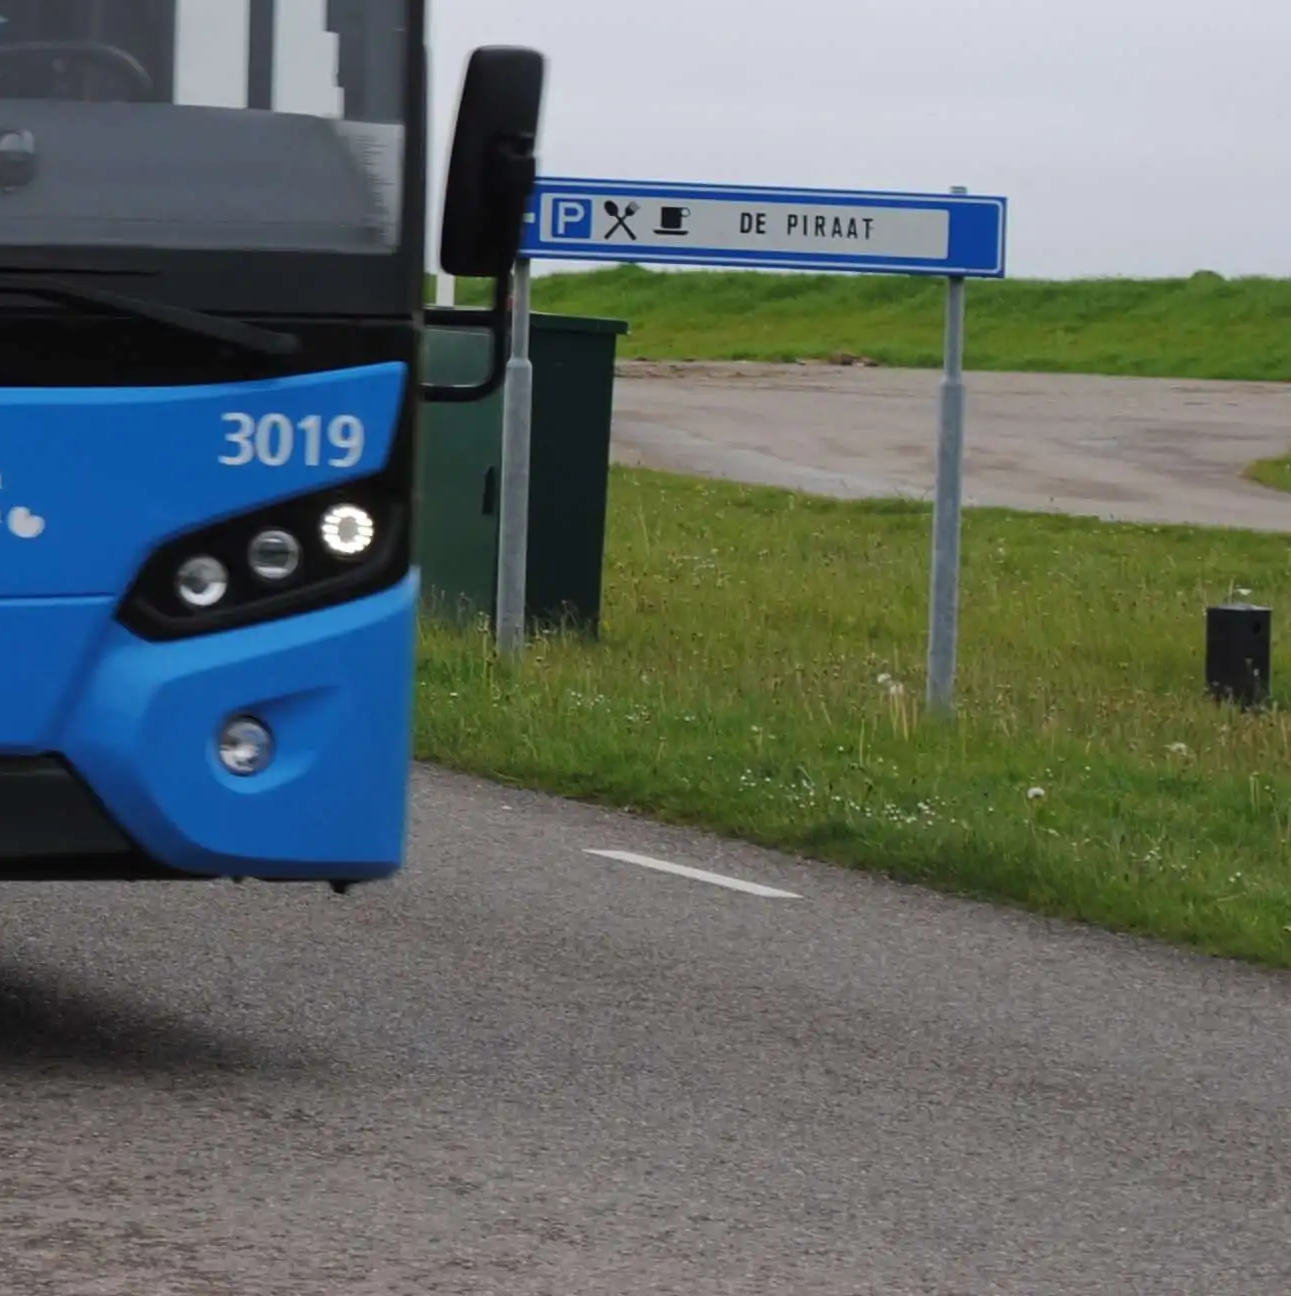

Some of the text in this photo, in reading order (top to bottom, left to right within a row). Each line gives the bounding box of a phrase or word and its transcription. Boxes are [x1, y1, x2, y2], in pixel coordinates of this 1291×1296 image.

[739, 212, 767, 235] DE
[786, 213, 874, 240] PIRAAT
[217, 411, 365, 468] 3019
